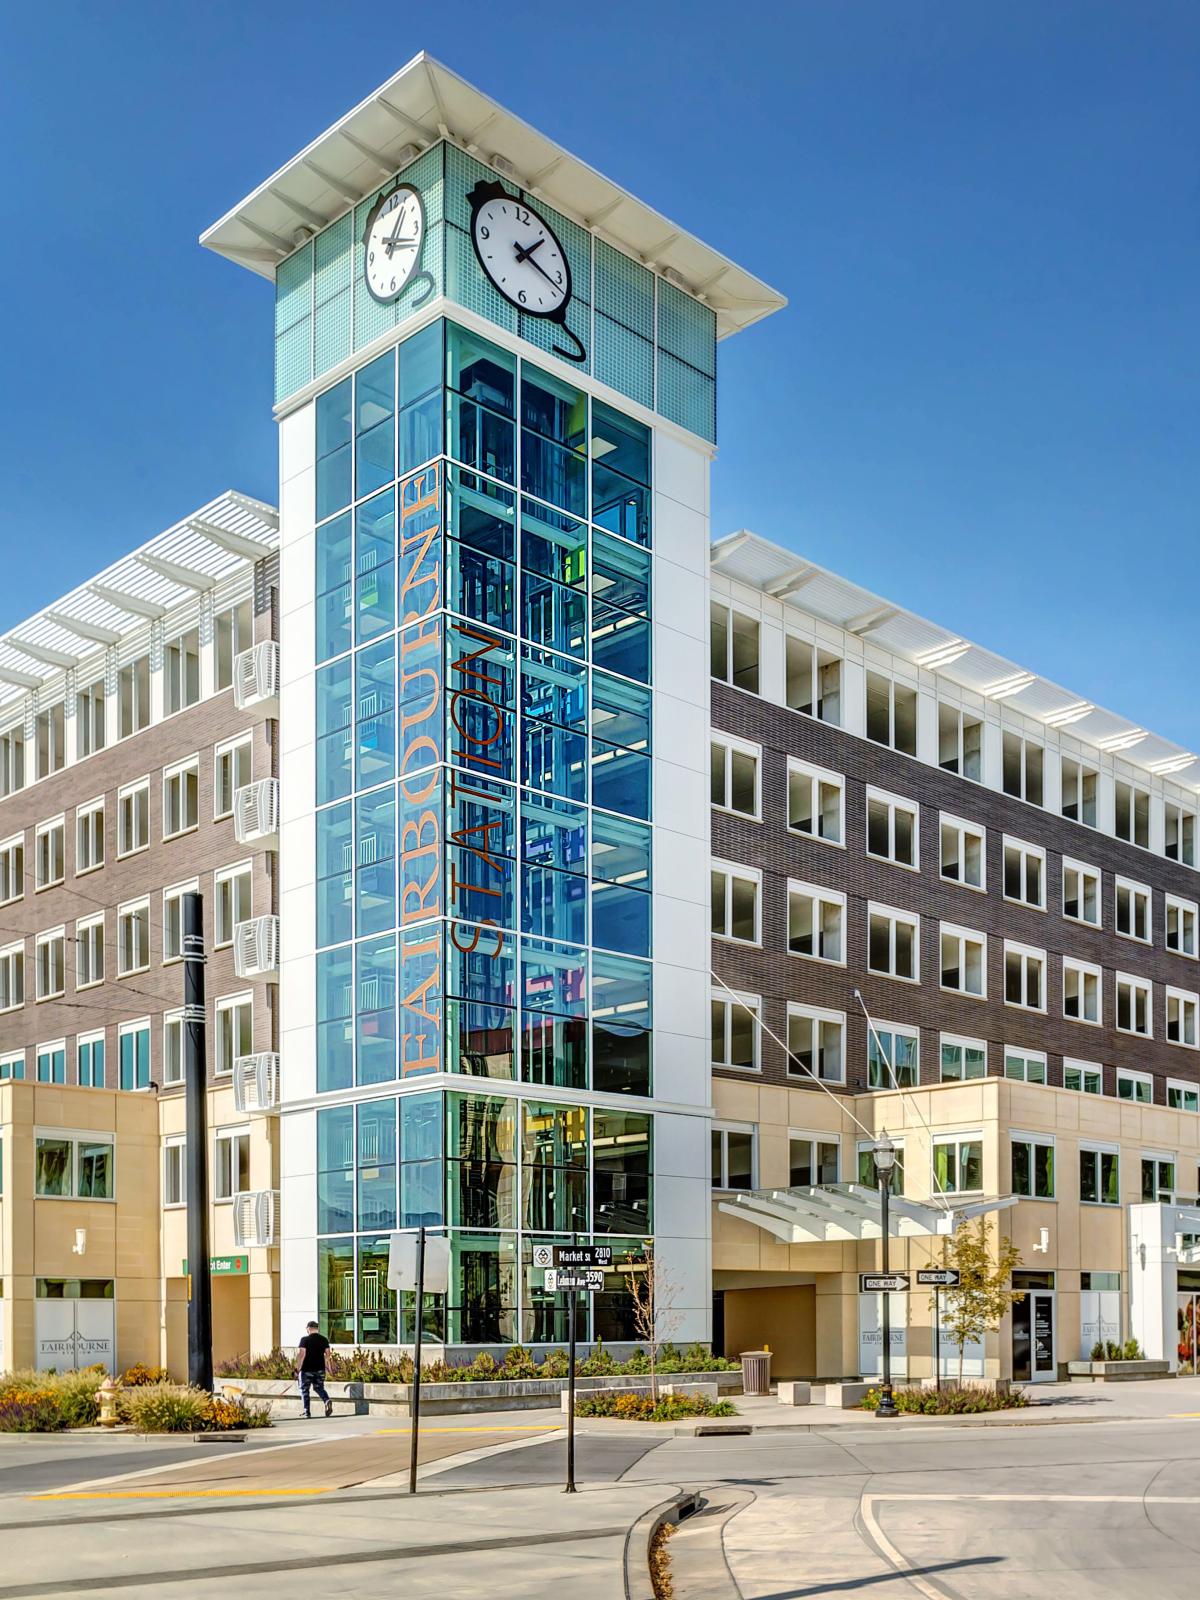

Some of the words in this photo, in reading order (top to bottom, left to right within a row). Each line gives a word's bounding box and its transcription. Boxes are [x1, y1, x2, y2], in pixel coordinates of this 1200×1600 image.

[389, 194, 399, 212] 12
[515, 206, 531, 226] 12
[413, 220, 419, 236] 3
[480, 226, 490, 240] 9
[369, 251, 375, 267] 9
[390, 276, 396, 291] 6
[554, 270, 563, 284] 3
[517, 290, 527, 303] 6
[402, 462, 440, 1078] FAIRBOURNE
[451, 623, 504, 961] STATION
[559, 1251, 584, 1261] Market
[595, 1248, 610, 1258] 2810
[217, 1260, 231, 1270] Enter
[586, 1271, 602, 1282] 3590
